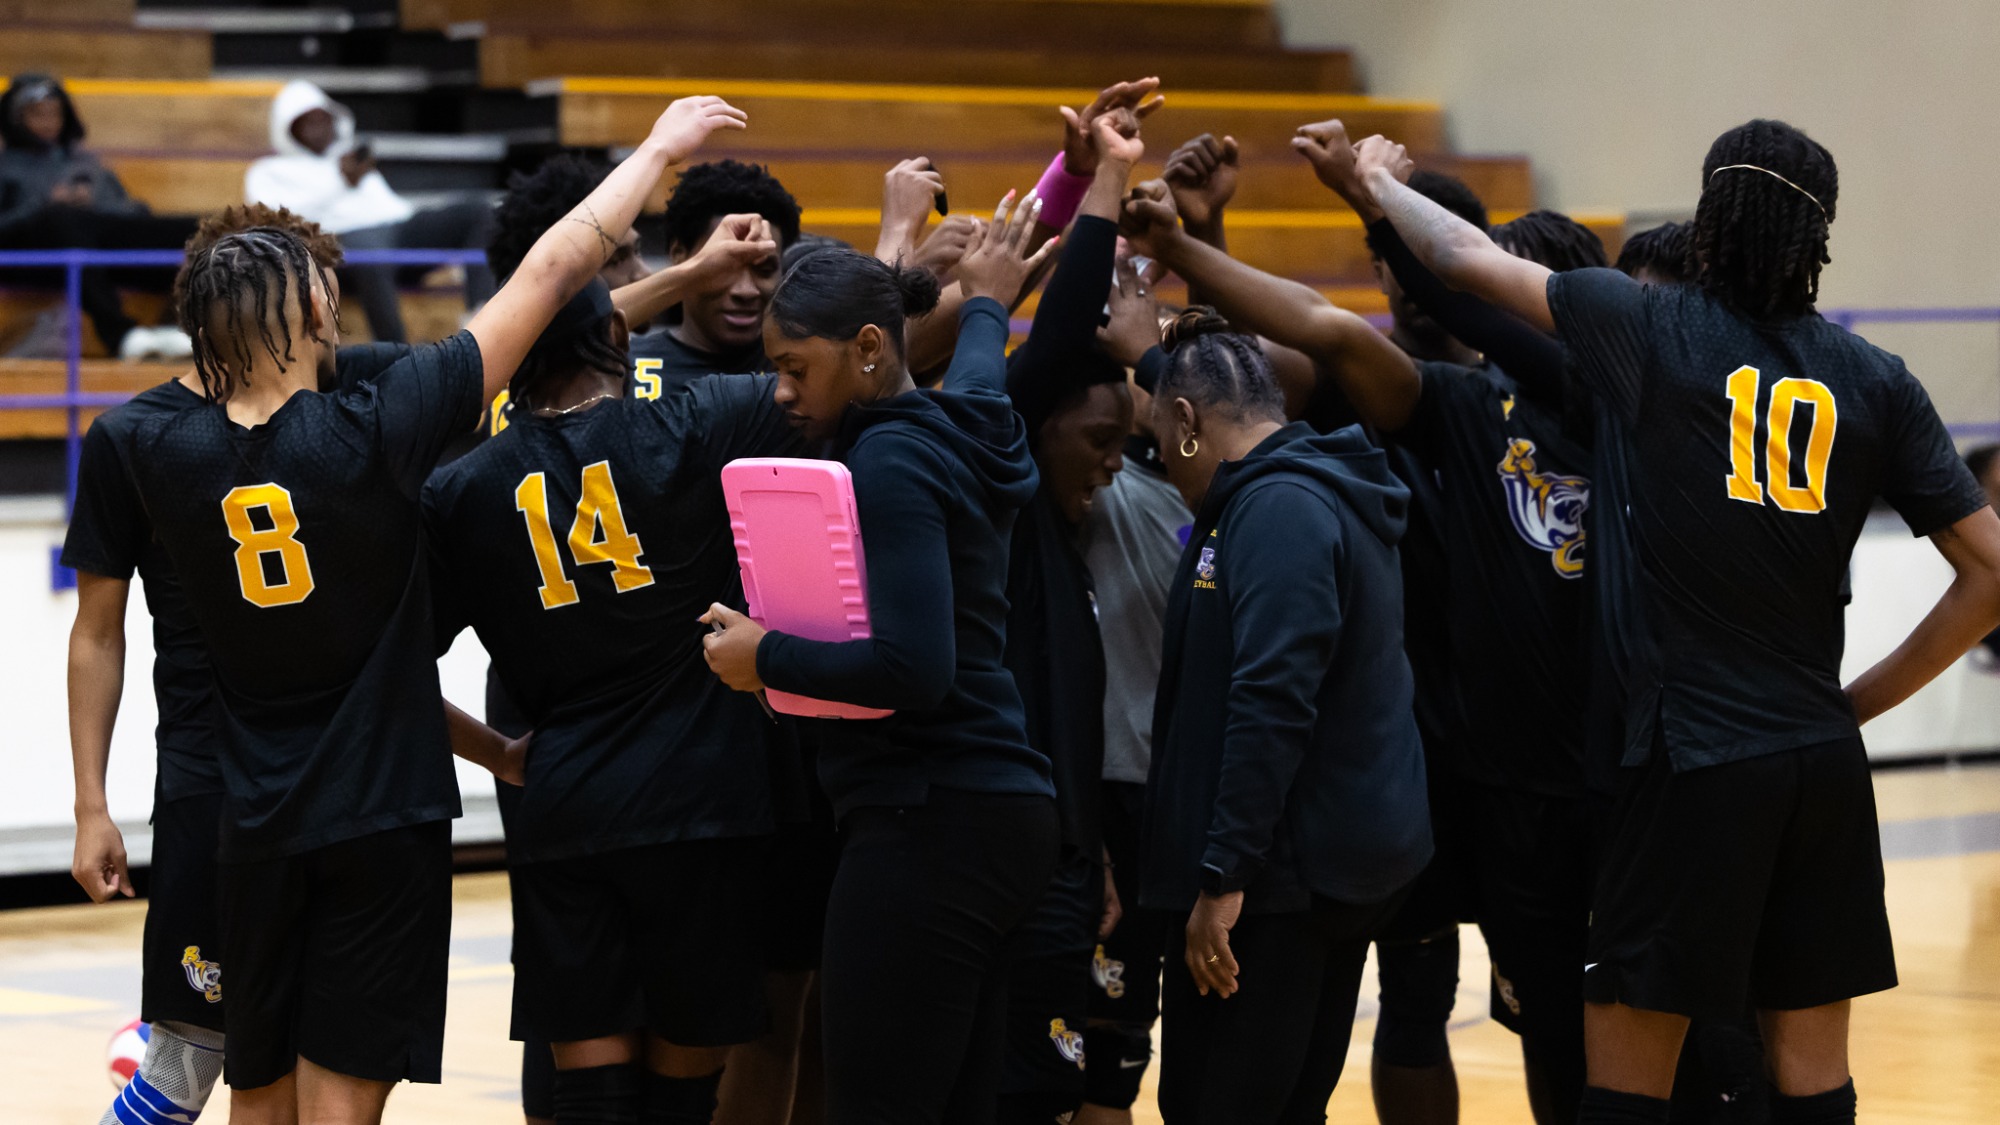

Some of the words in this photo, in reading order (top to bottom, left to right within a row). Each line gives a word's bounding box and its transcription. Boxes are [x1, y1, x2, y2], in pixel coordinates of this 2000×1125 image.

[1725, 364, 1838, 515] 10
[221, 481, 315, 609] 8
[514, 460, 656, 610] 14
